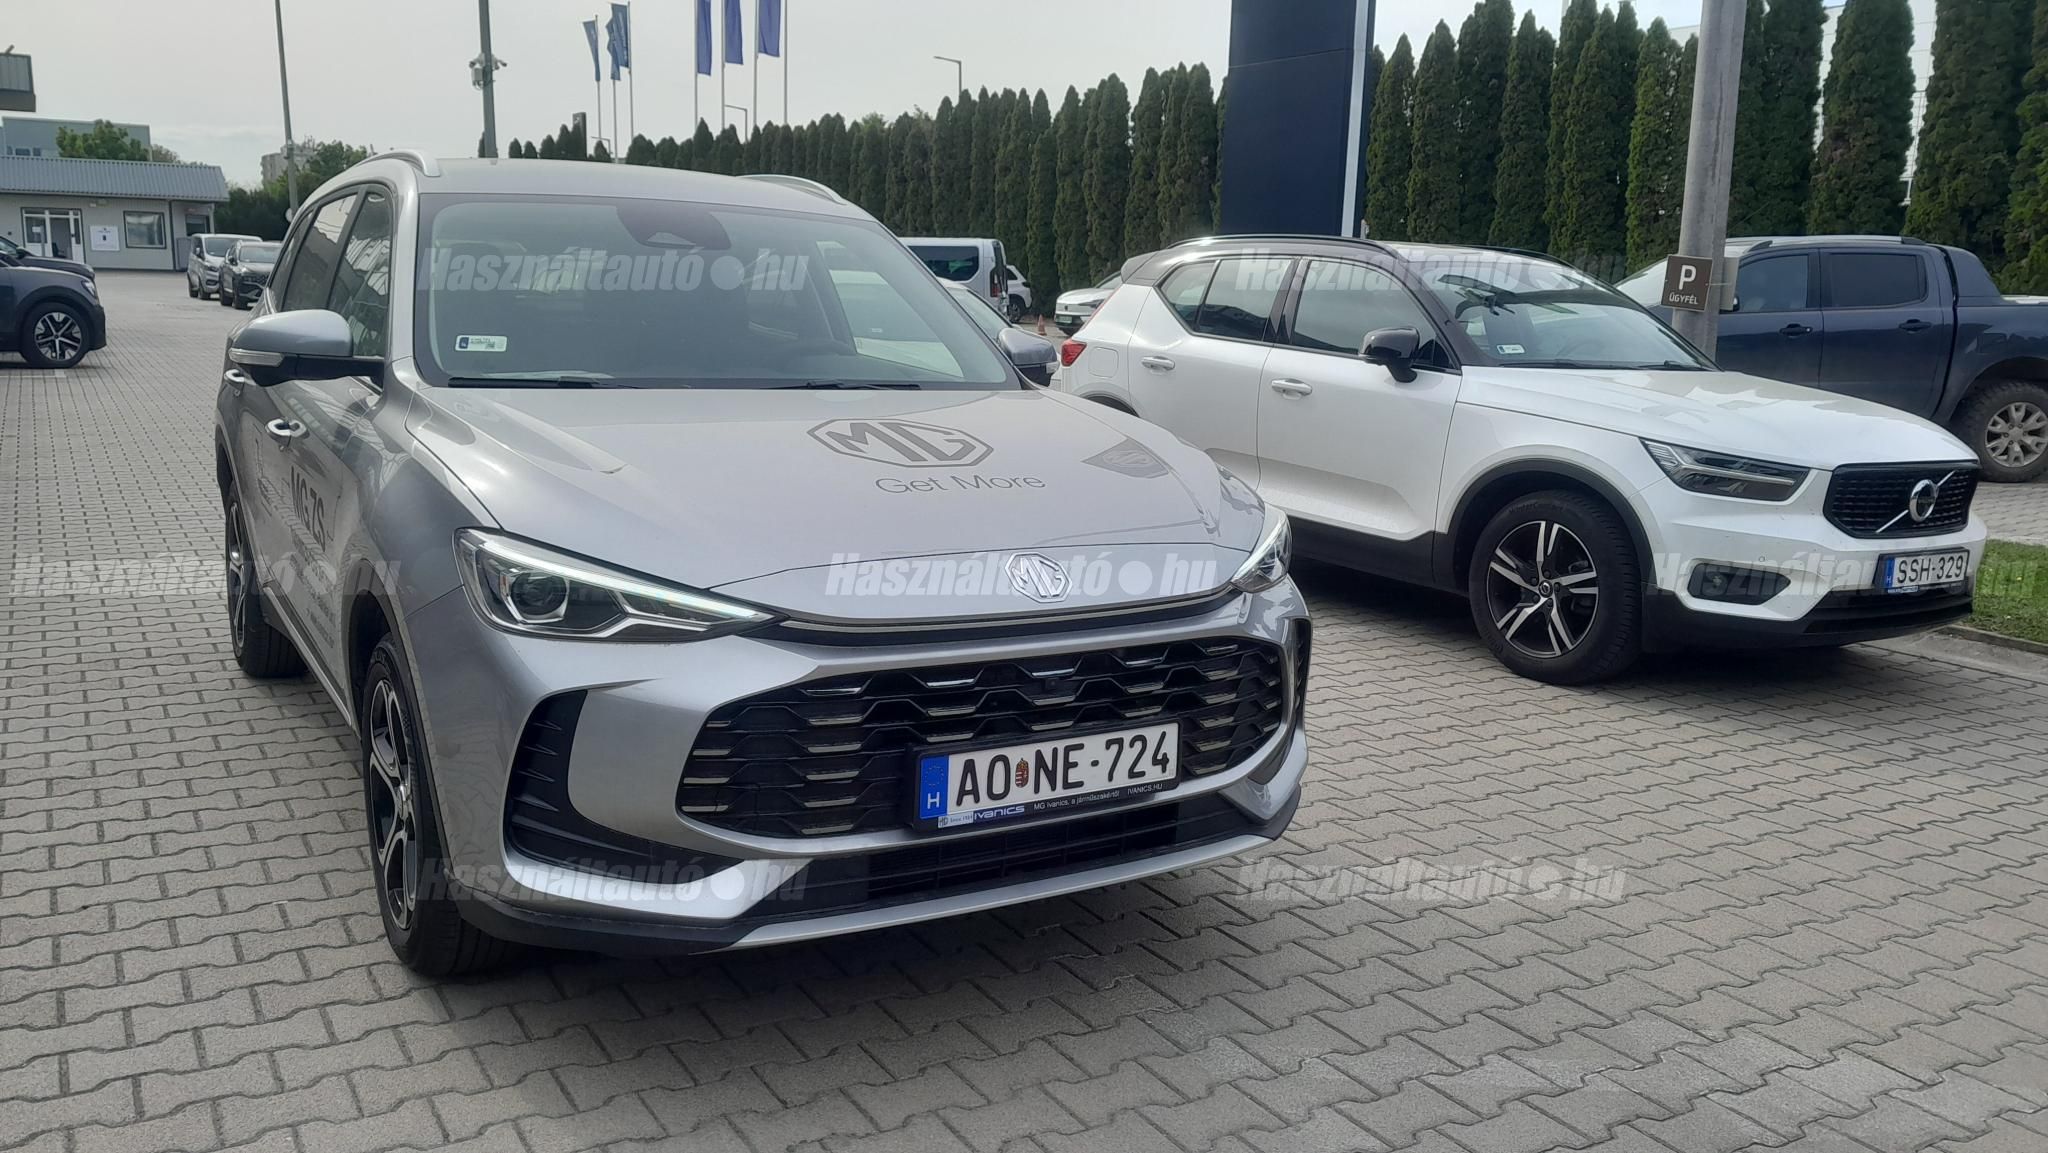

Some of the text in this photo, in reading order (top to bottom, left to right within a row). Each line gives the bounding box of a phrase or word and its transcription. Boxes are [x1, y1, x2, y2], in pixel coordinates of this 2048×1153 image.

[1679, 264, 1697, 290] P
[1669, 292, 1698, 305] ÜGYFÉL
[826, 422, 976, 462] MG
[875, 473, 1046, 494] Get More
[1008, 555, 1066, 597] MG
[1897, 555, 1964, 583] SSH-329
[927, 791, 941, 809] H
